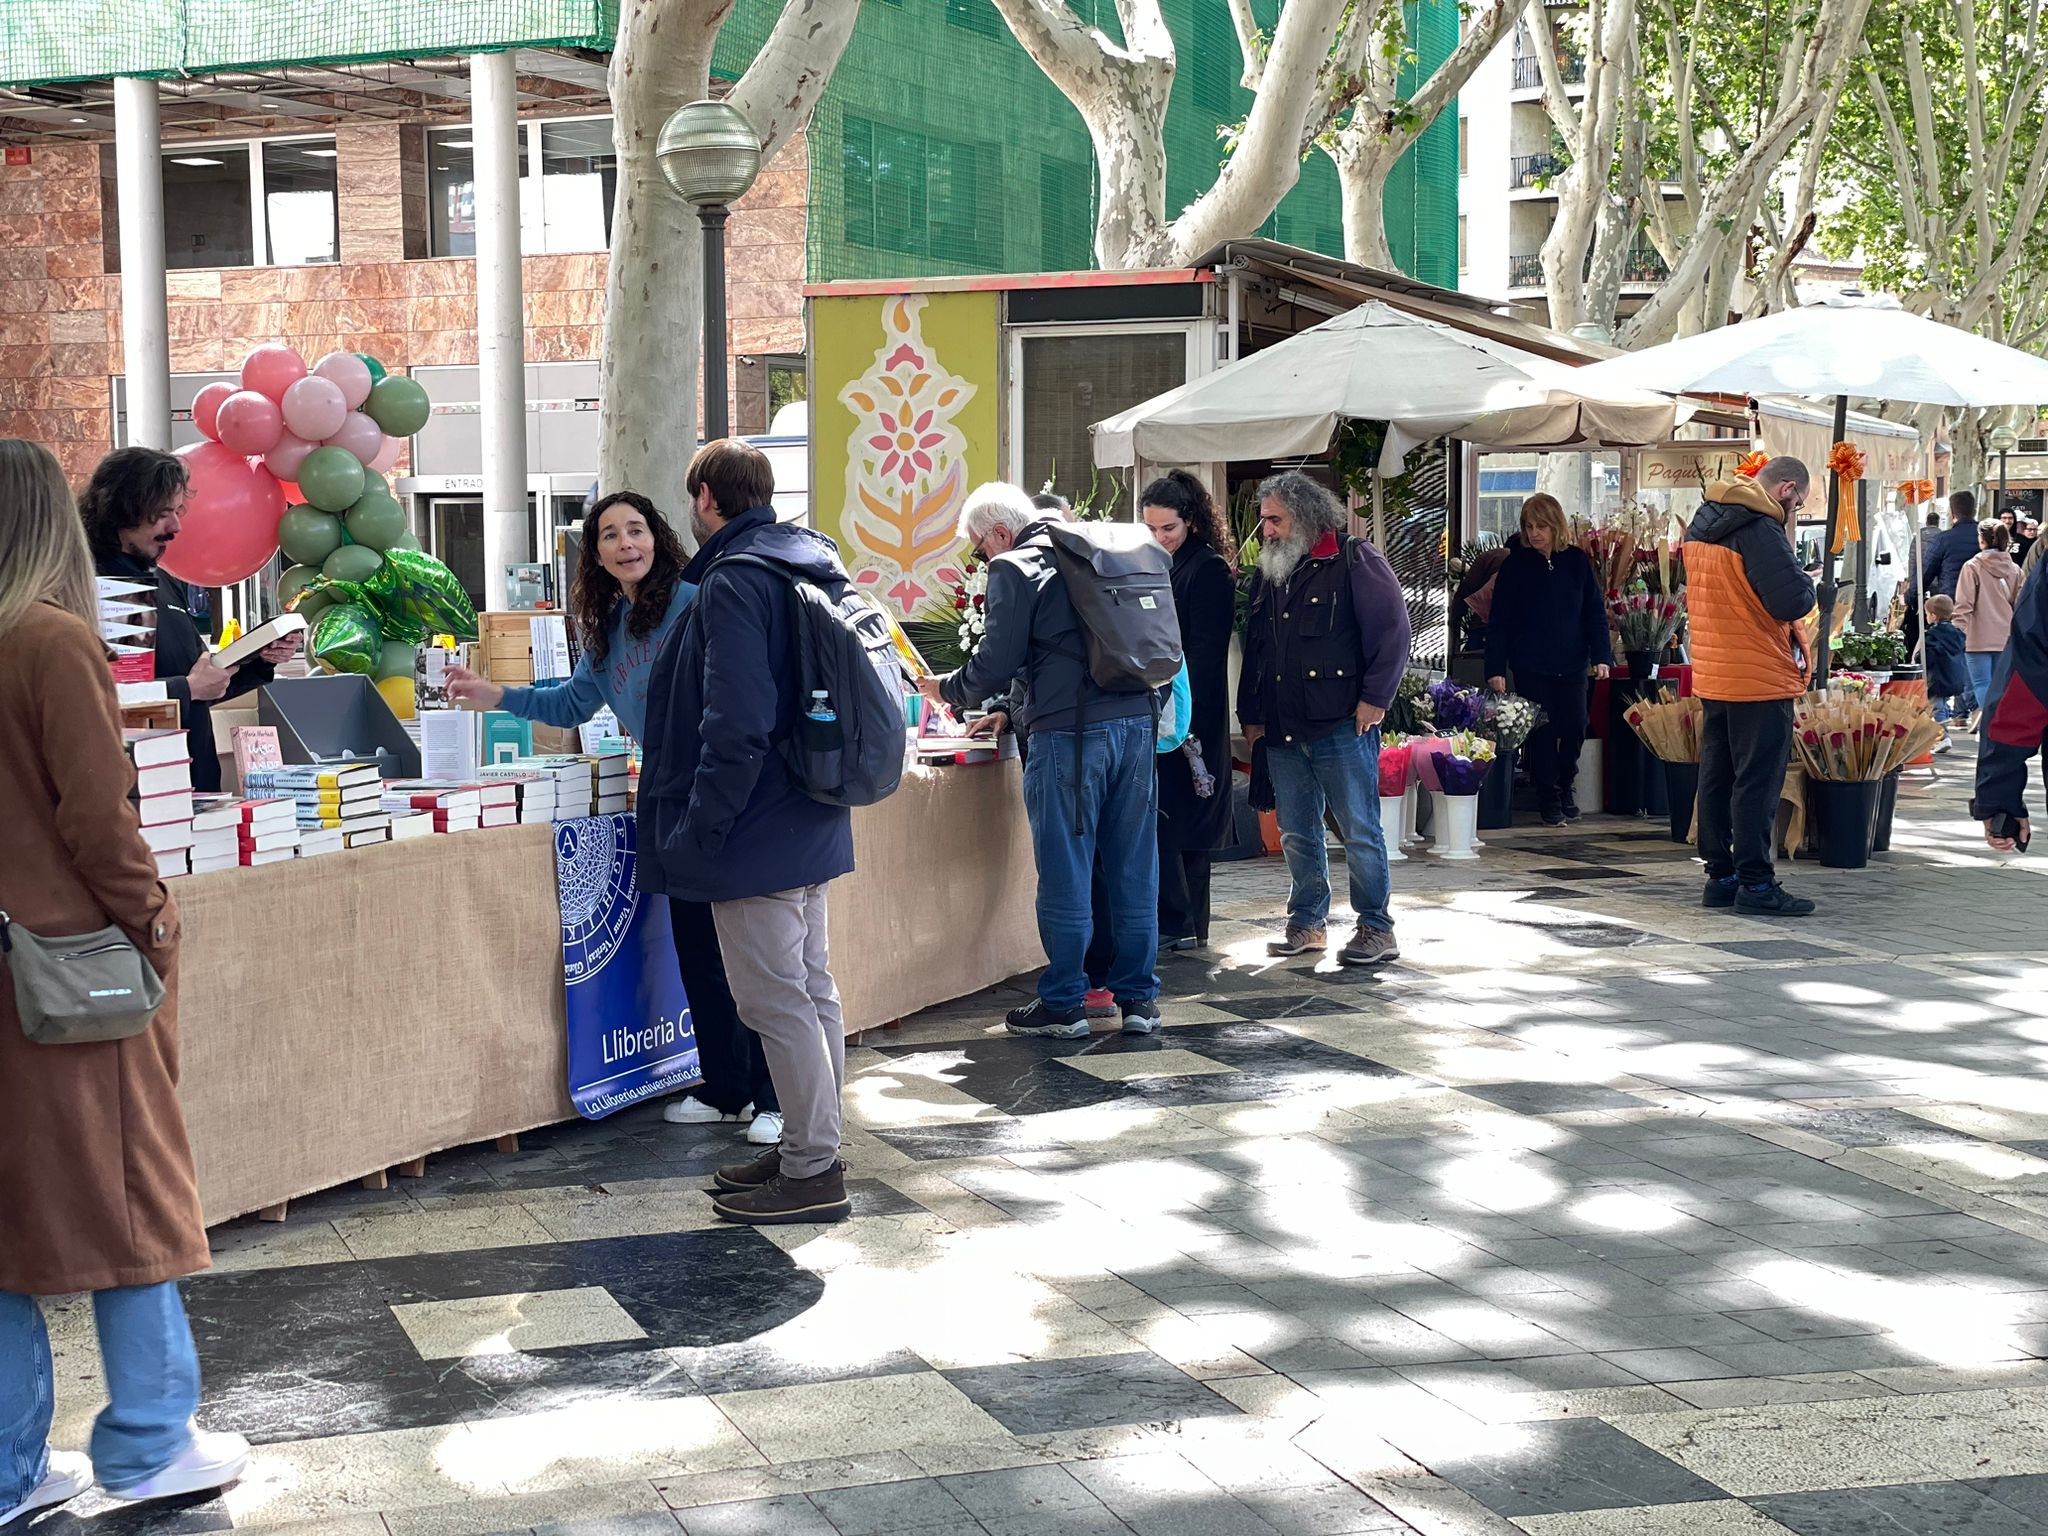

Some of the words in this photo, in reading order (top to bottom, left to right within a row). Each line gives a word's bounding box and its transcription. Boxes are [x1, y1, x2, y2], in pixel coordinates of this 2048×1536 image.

[445, 478, 484, 489] ENTRAD
[561, 831, 577, 854] A
[602, 891, 613, 910] H
[613, 907, 631, 935] Virtus
[567, 926, 576, 941] K
[602, 1016, 675, 1064] Llibreria
[584, 1101, 600, 1115] La
[599, 1087, 639, 1111] Llibreria
